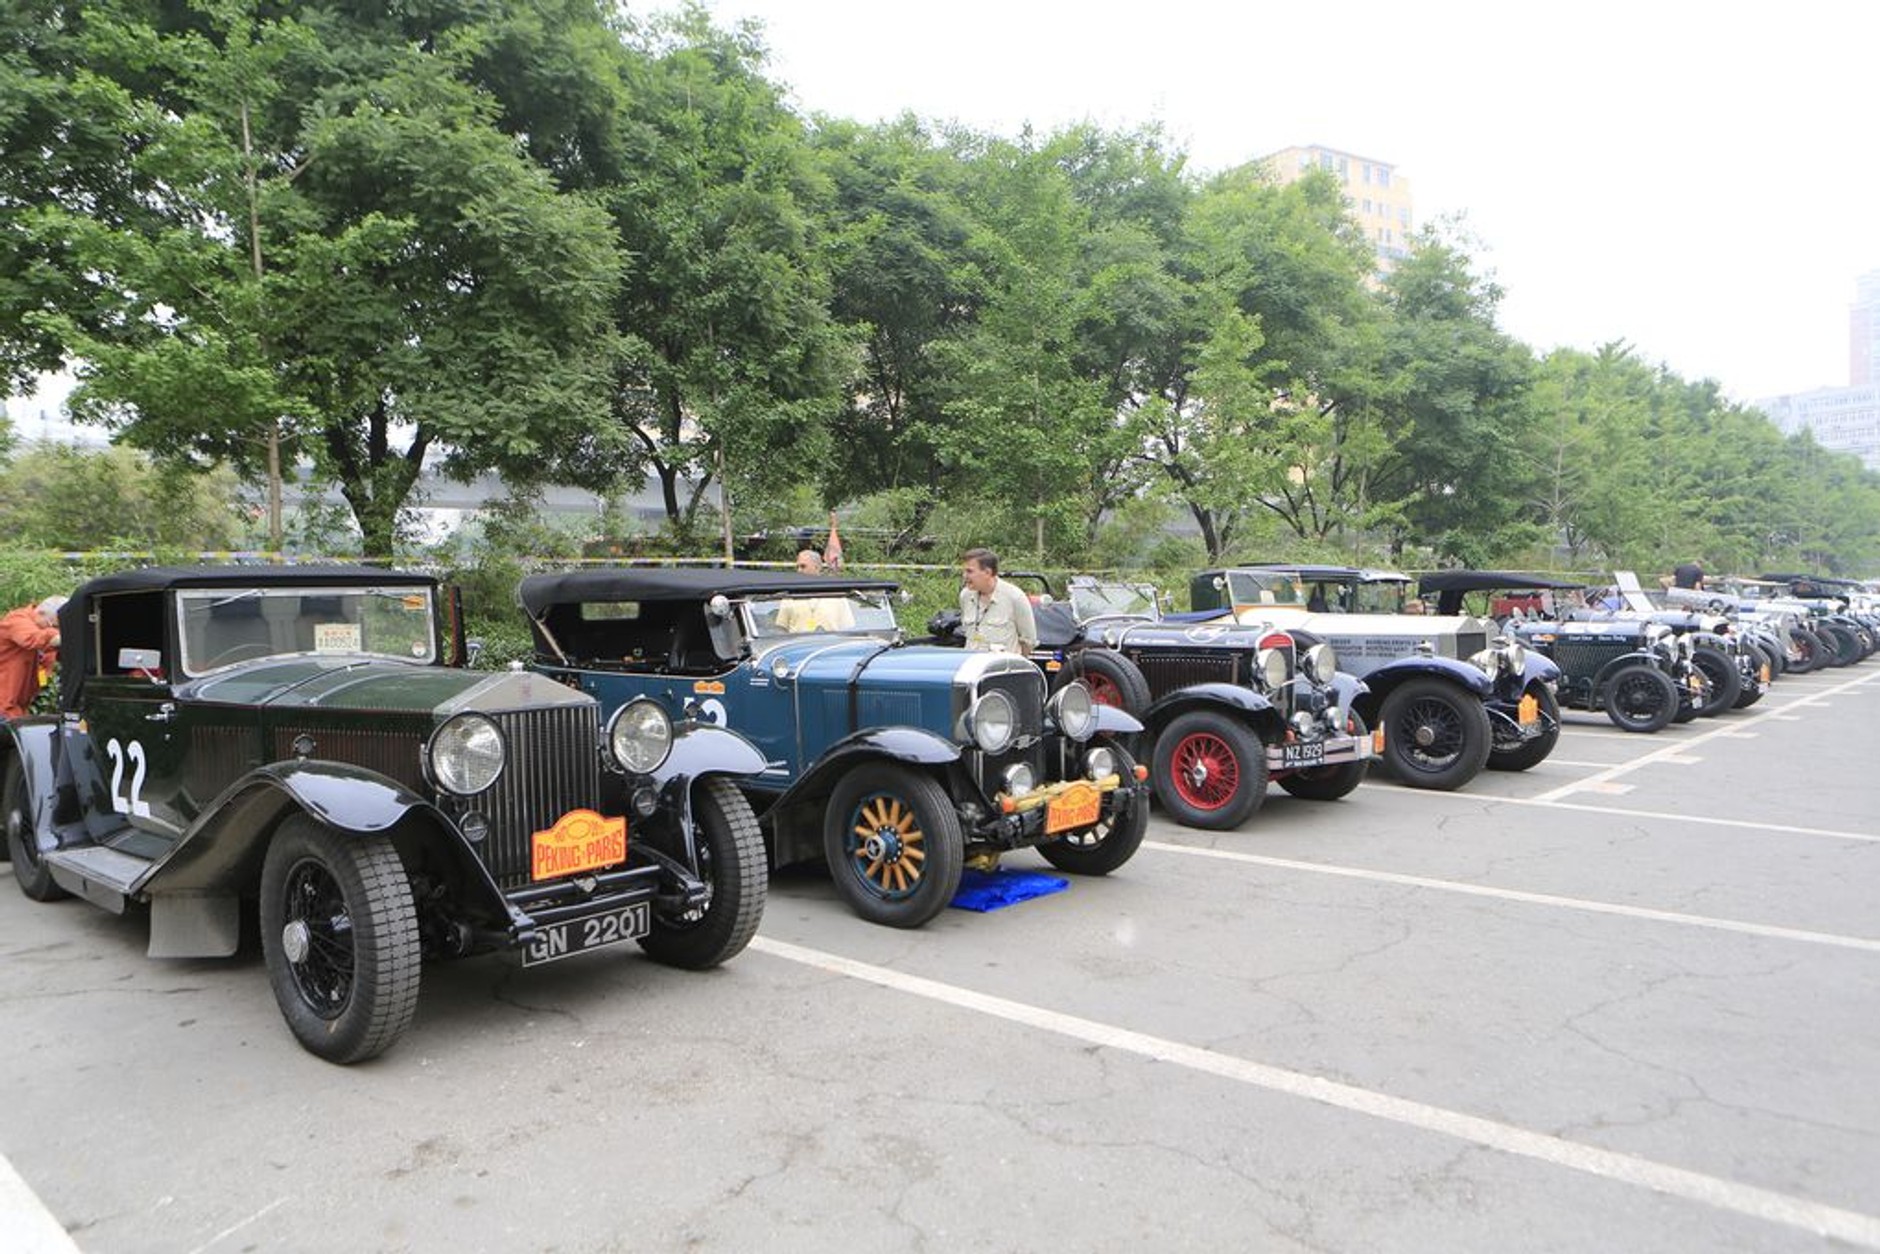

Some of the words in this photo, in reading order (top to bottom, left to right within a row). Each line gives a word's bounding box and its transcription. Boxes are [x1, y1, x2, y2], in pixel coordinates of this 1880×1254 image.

[106, 738, 151, 818] 22
[1286, 745, 1301, 760] NZ
[531, 925, 568, 959] GN
[584, 907, 645, 948] 2201
